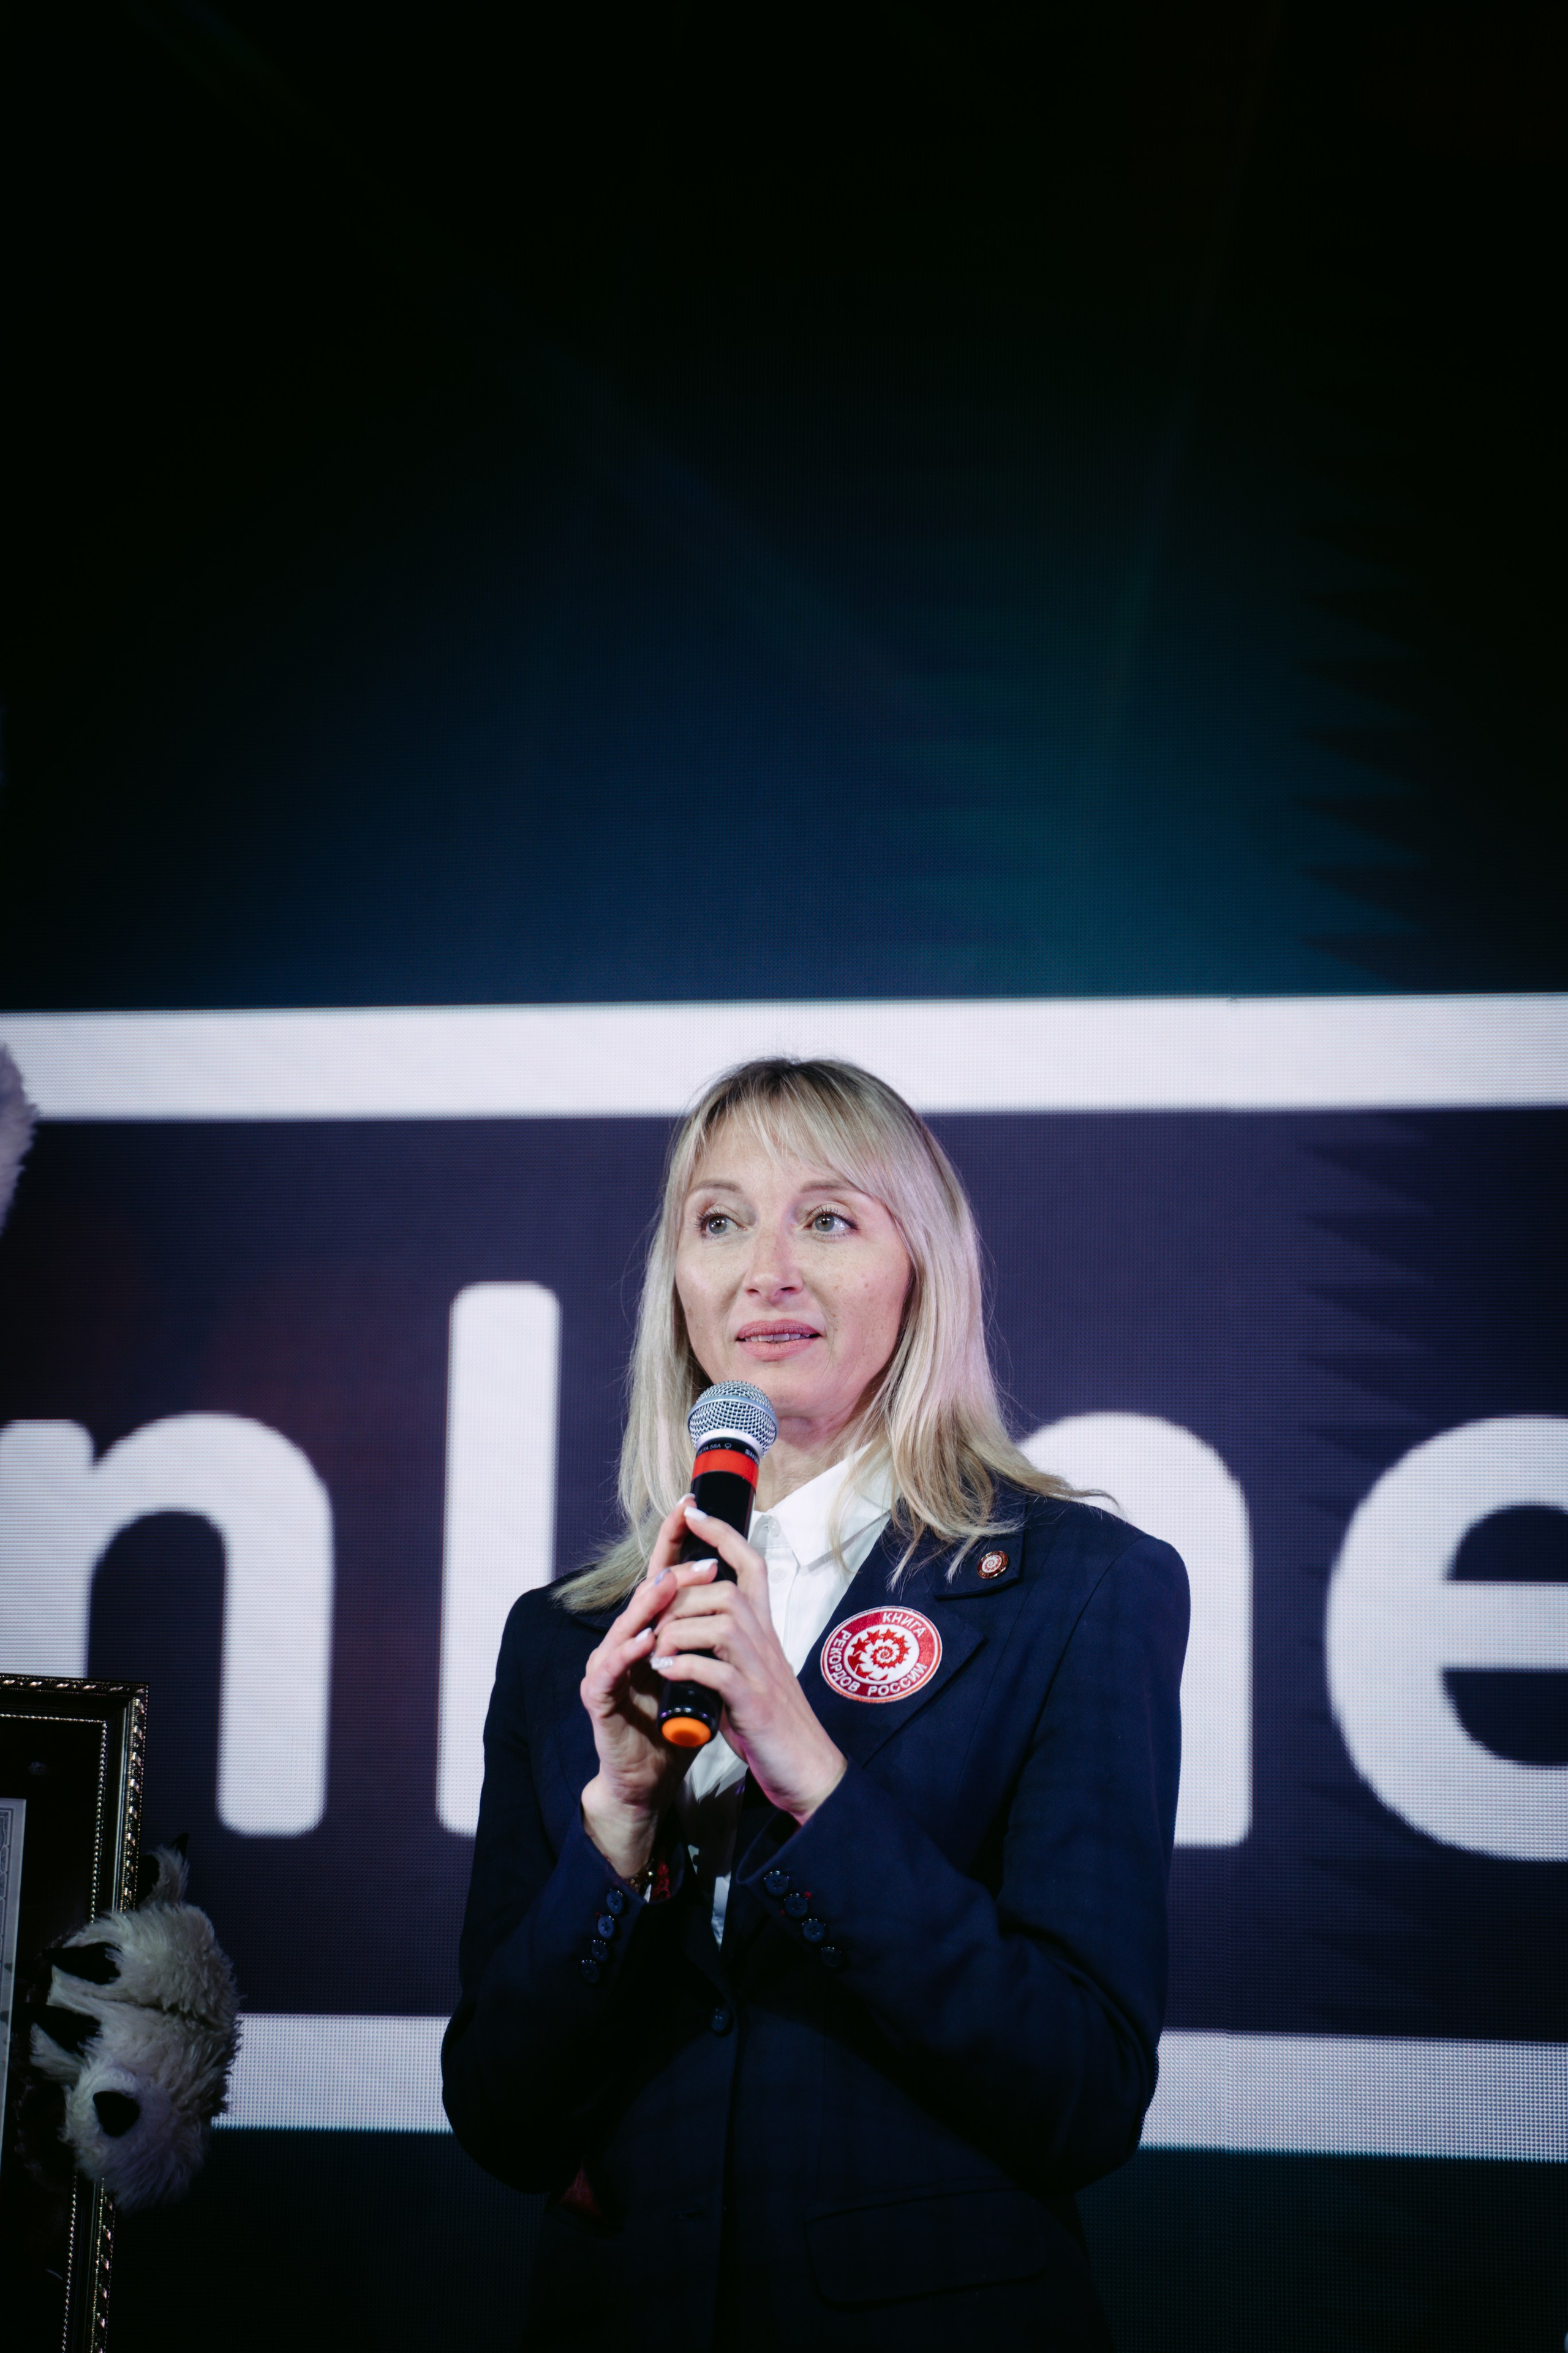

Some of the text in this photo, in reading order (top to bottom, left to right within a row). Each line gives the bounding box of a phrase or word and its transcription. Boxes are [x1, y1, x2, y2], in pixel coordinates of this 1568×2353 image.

[0, 1280, 1568, 1862] nlne
[827, 1611, 929, 1697] КНИГА РЕКОРДОВ РОССИИ
